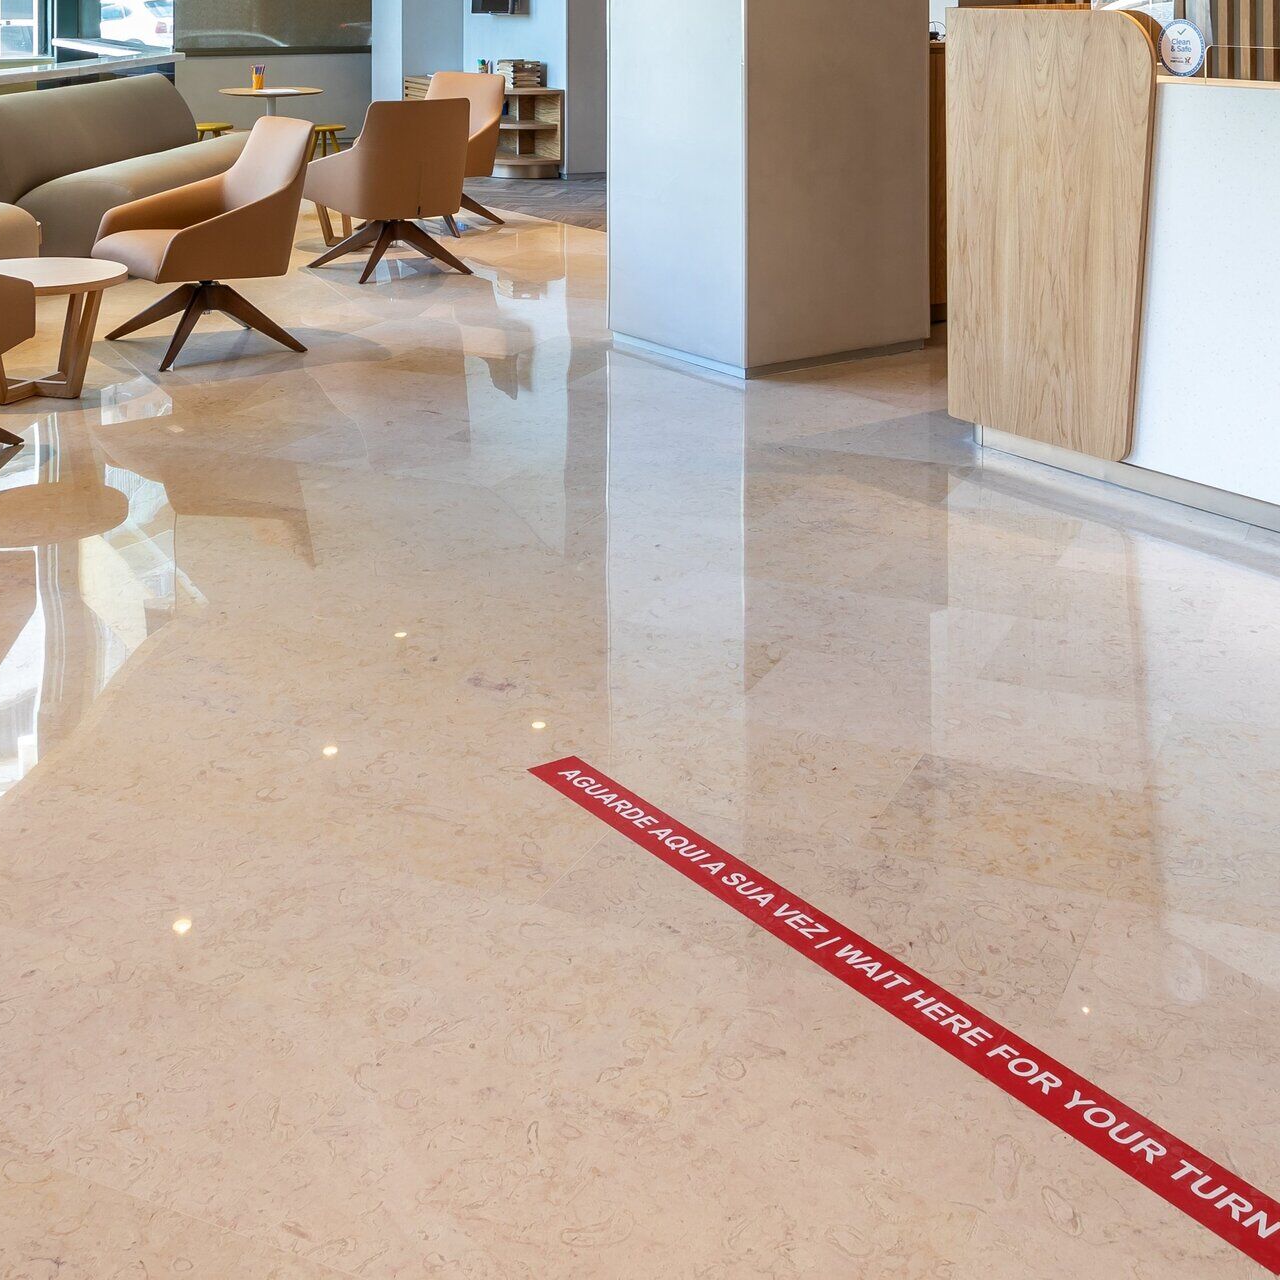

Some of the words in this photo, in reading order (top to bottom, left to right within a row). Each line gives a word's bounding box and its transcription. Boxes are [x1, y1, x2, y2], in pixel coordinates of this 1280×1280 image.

[557, 768, 660, 829] AGUARDE
[647, 827, 712, 864] AQUI
[698, 861, 727, 876] A
[721, 872, 775, 908] SUA
[772, 902, 830, 940] VEZ
[834, 943, 912, 989] WAIT
[901, 988, 994, 1047] HERE
[986, 1043, 1063, 1095] FOR
[1063, 1089, 1168, 1165] YOUR
